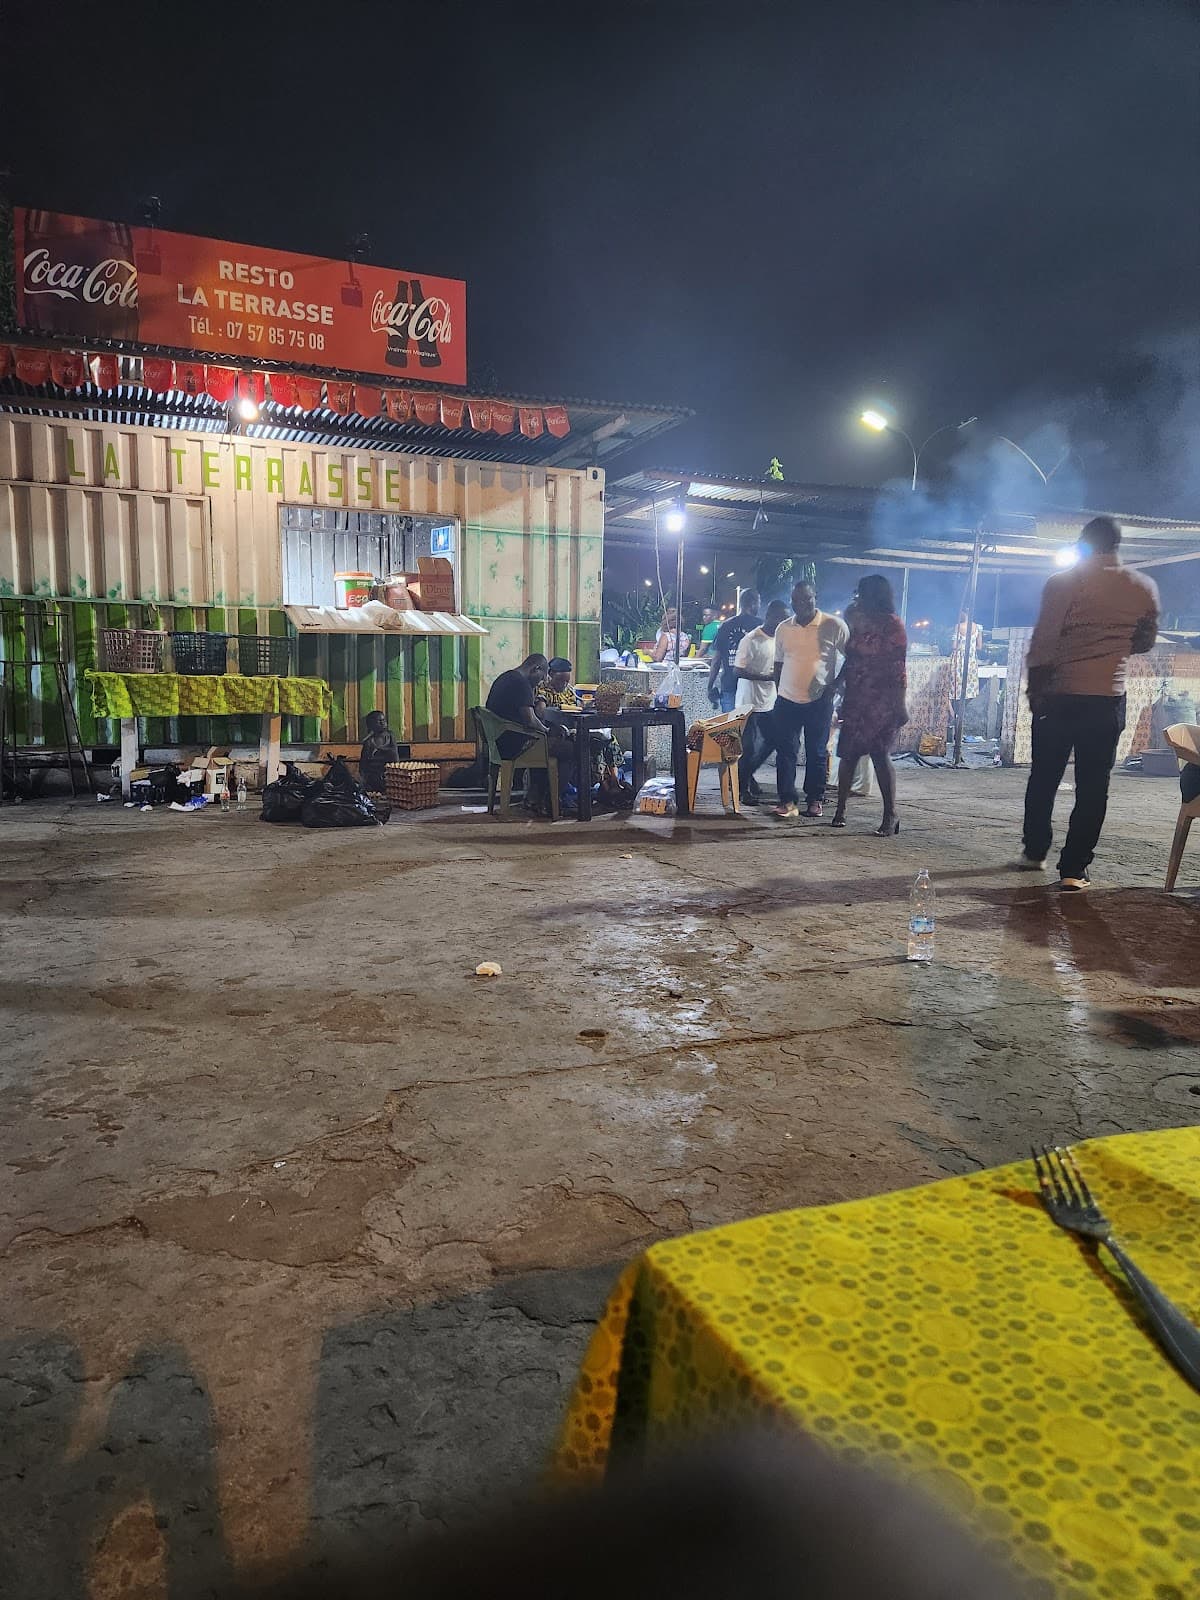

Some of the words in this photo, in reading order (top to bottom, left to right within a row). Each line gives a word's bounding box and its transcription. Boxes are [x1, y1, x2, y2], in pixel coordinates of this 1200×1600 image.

[219, 260, 295, 290] RESTO
[177, 283, 208, 307] LA
[214, 289, 334, 326] TERRASSE
[370, 290, 452, 343] Coca-Cola
[188, 315, 213, 336] Tél.
[226, 321, 243, 339] 07
[247, 324, 264, 343] 57
[268, 327, 285, 345] 85
[289, 330, 305, 348] 75
[308, 332, 325, 350] 08
[66, 438, 120, 480] LA
[170, 448, 400, 503] TERRASSE
